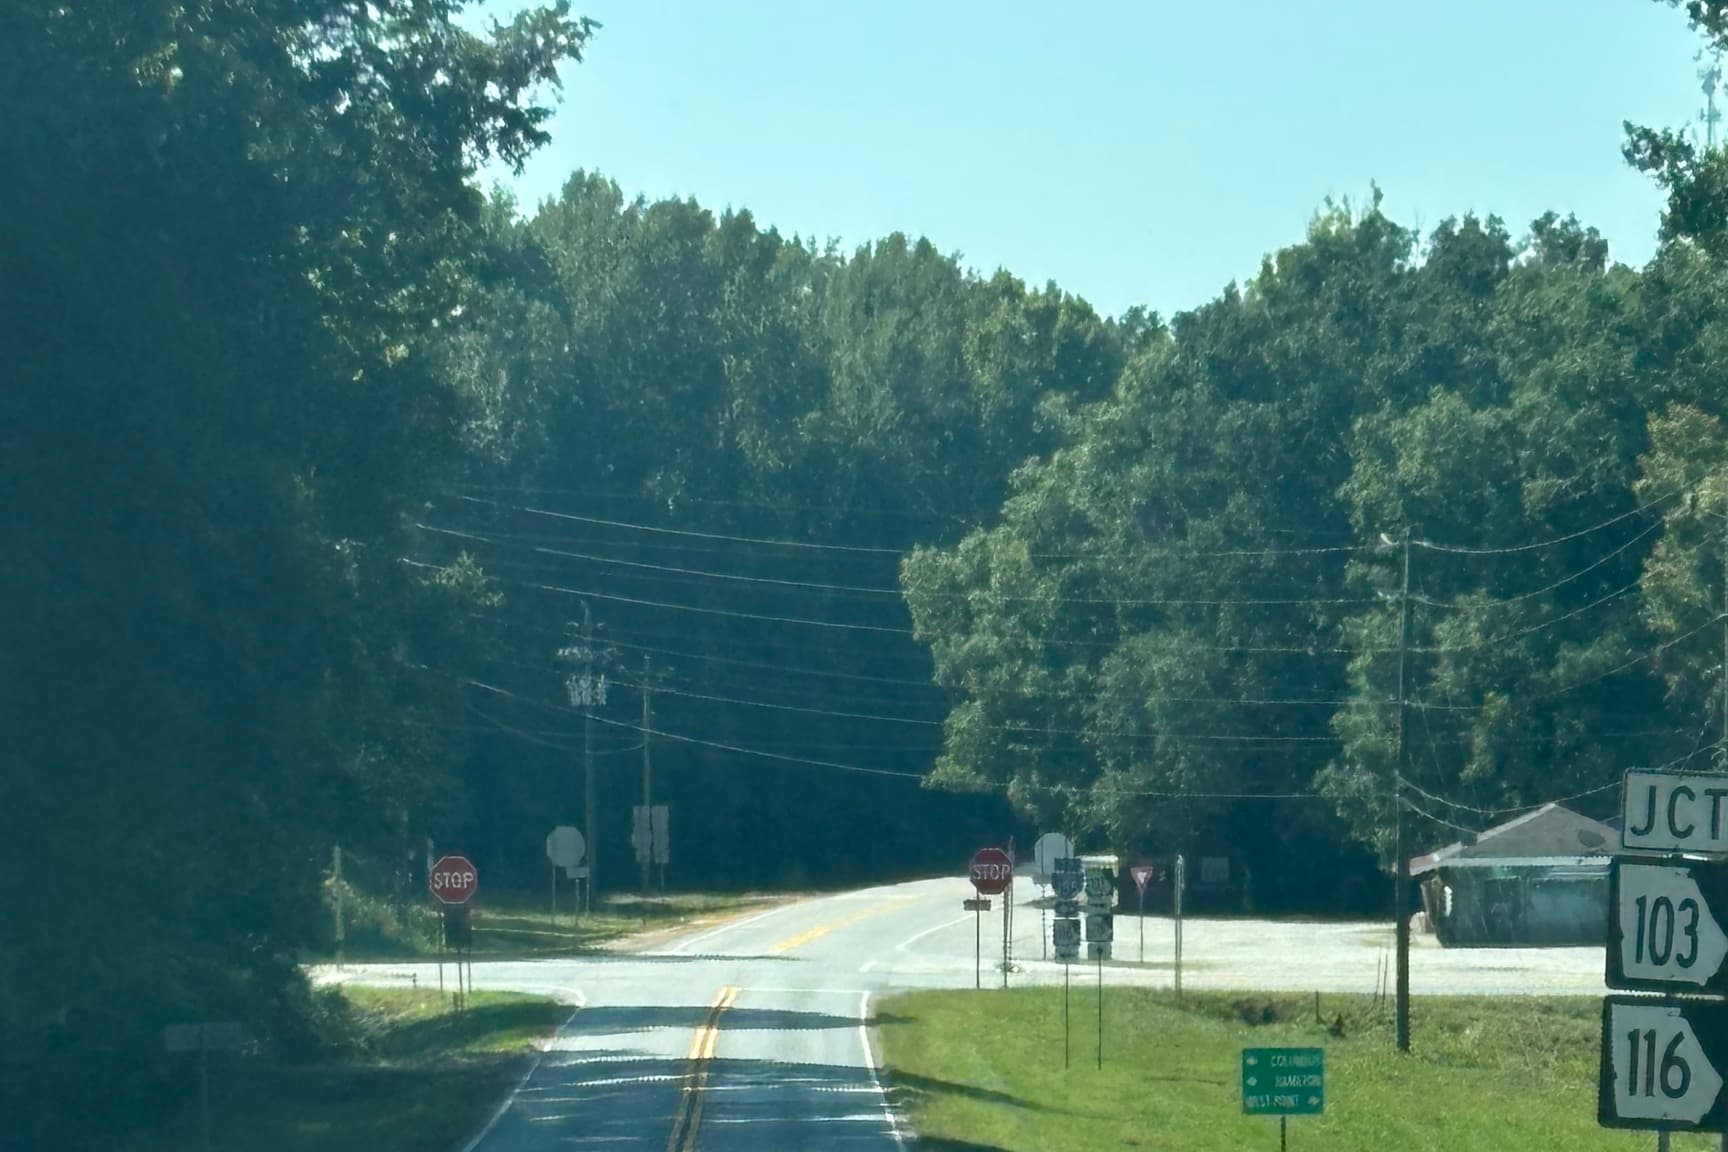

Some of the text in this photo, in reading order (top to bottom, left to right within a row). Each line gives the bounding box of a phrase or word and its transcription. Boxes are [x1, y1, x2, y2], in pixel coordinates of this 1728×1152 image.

[1630, 785, 1728, 840] JCT
[434, 872, 474, 890] STOP
[972, 864, 1010, 880] STOP
[1635, 895, 1699, 969] 103
[1628, 1028, 1691, 1098] 116
